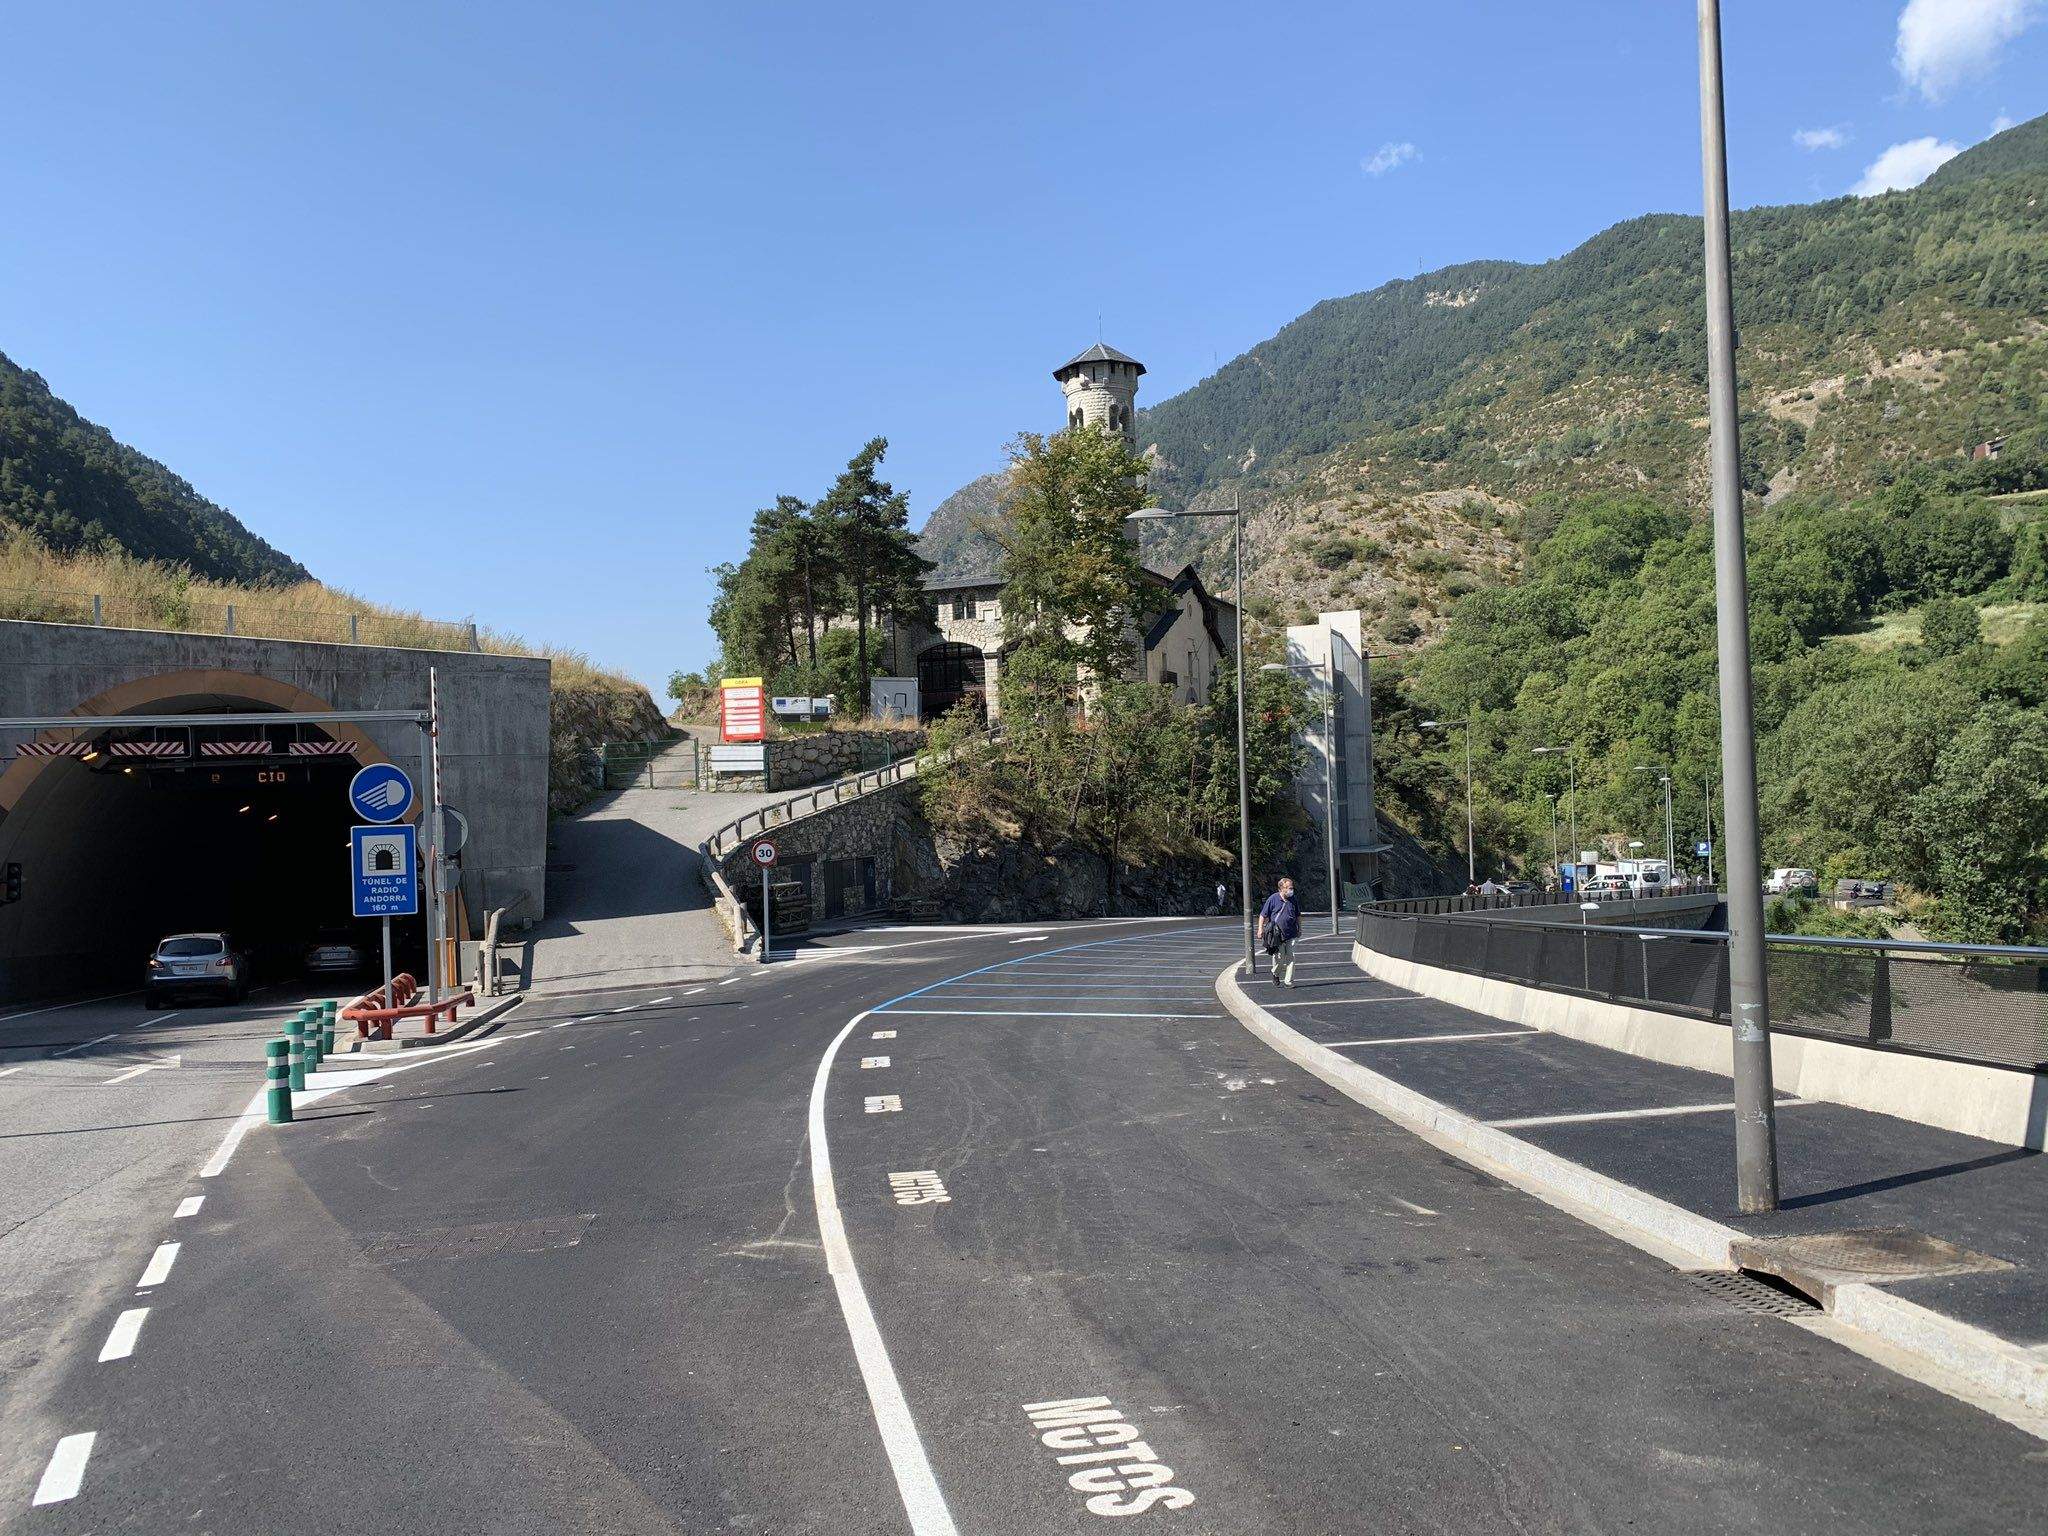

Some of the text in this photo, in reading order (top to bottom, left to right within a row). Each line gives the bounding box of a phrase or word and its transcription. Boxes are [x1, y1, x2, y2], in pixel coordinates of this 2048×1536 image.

[758, 849, 773, 858] 30
[362, 877, 408, 885] TÚNEL DE
[371, 886, 399, 894] RADIO
[363, 894, 408, 903] ANDORRA
[887, 1169, 952, 1205] MOTOS
[1021, 1395, 1196, 1517] MOTOS
